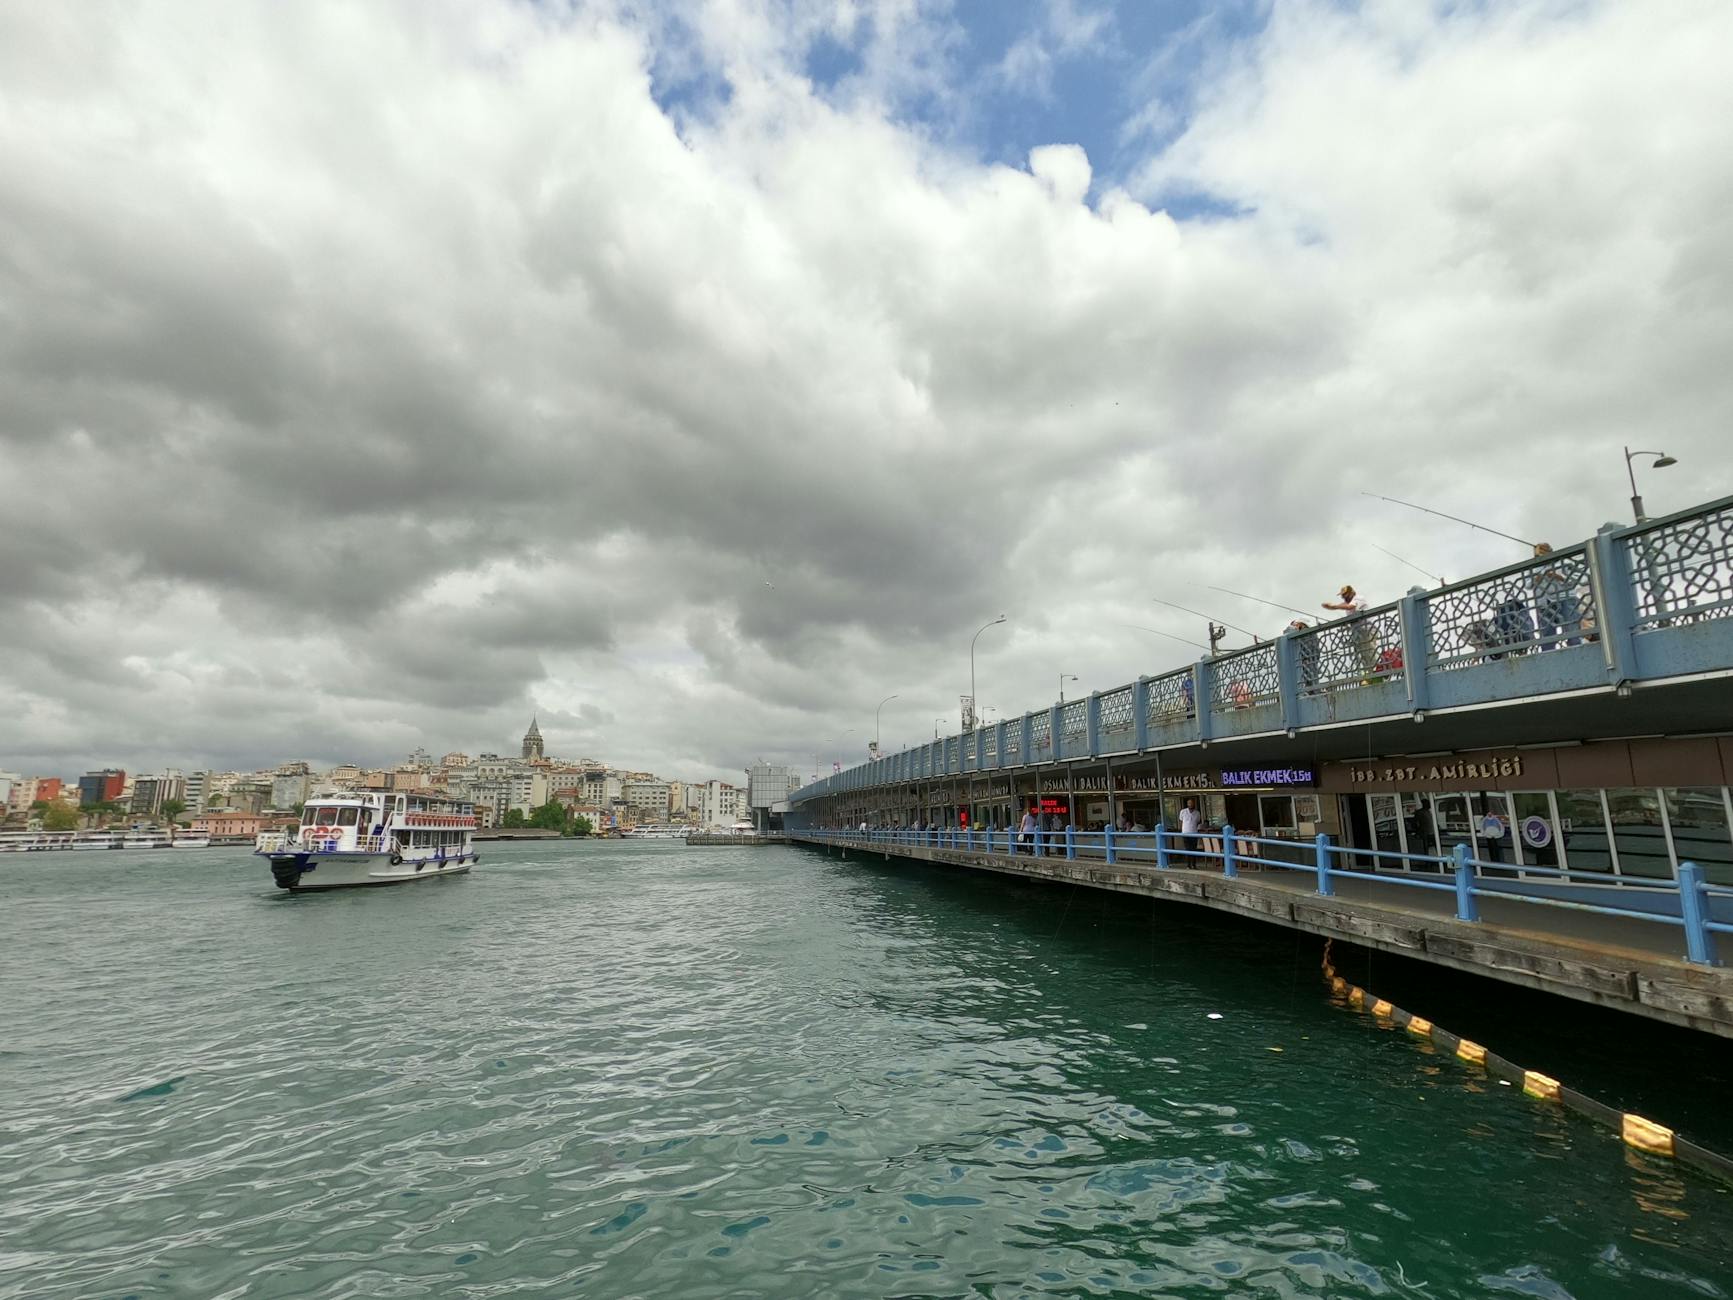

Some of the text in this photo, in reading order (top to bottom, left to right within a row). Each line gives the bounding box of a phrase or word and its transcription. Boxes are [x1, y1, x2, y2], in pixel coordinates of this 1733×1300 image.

[1222, 771, 1252, 784] BALIK
[1253, 769, 1292, 784] EKMEK
[1430, 756, 1521, 779] AMİRLİĞİ
